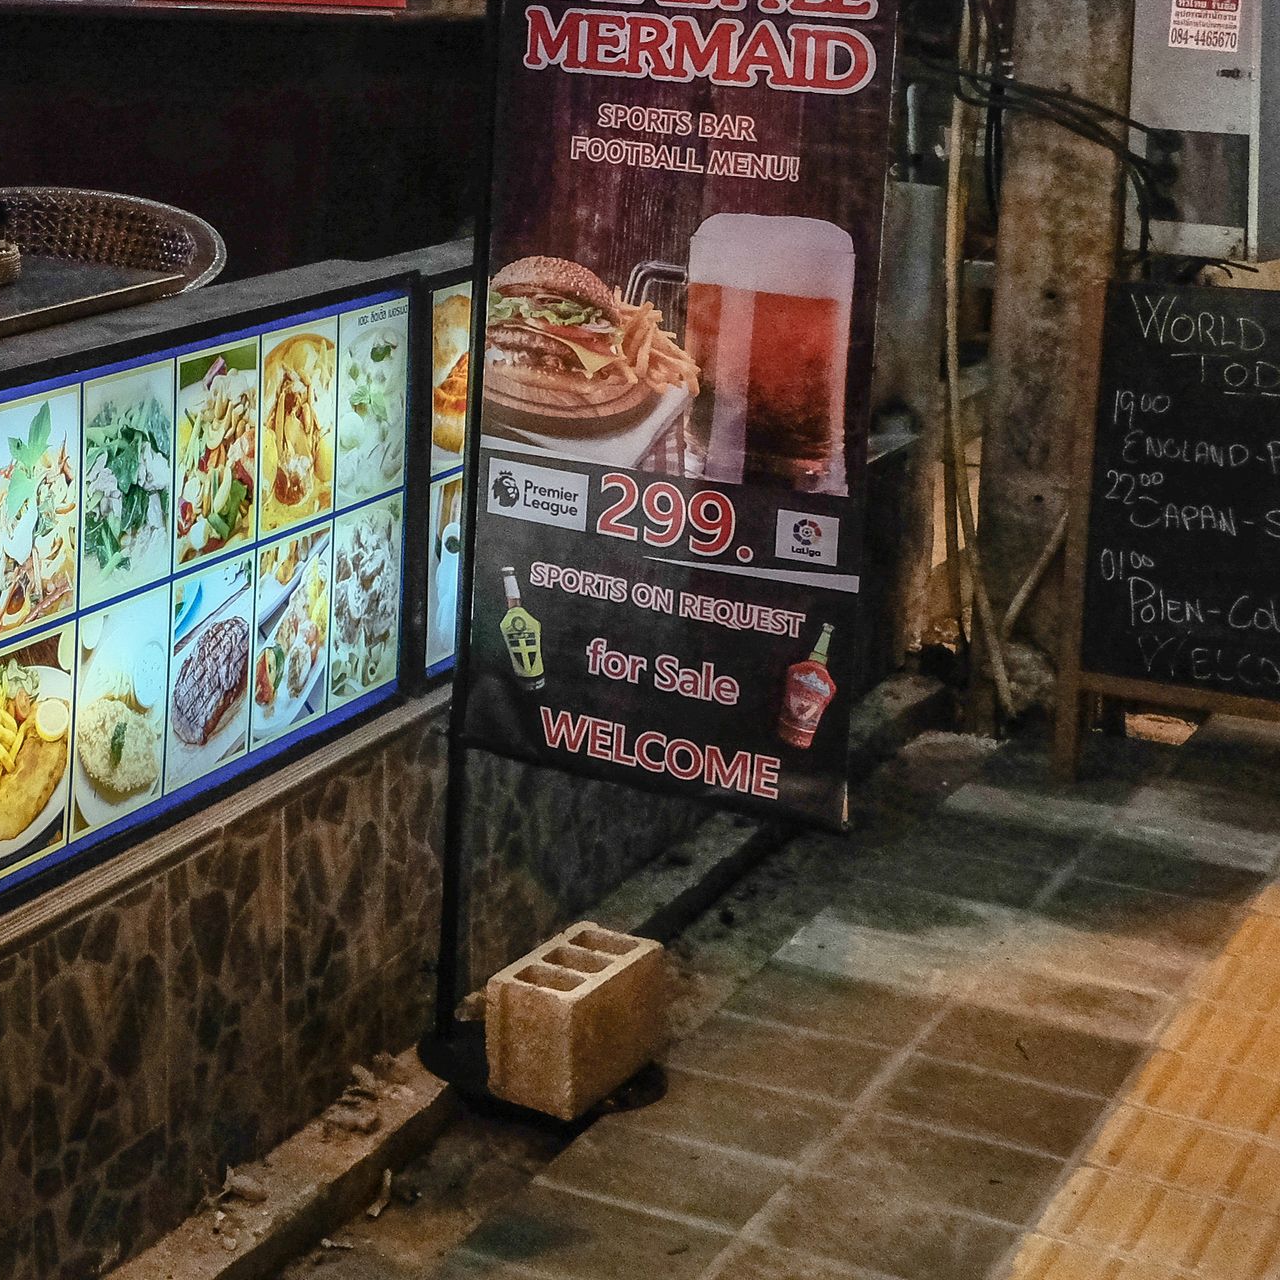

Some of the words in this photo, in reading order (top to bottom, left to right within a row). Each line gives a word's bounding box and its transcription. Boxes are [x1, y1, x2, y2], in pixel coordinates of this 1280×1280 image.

[523, 4, 877, 96] MERMAID
[1170, 27, 1237, 49] 084-4465670
[597, 103, 692, 136] SPORTS
[699, 113, 757, 143] BAR
[570, 135, 704, 174] FOOTBALL
[707, 151, 801, 183] MENU!
[1130, 293, 1266, 352] WORLD
[523, 479, 580, 505] Premier
[523, 495, 579, 518] League
[595, 471, 756, 564] 299.
[791, 545, 822, 558] LaLiga
[529, 561, 627, 603] SPORTS
[632, 582, 675, 614] ON
[679, 593, 807, 639] REQUEST
[586, 637, 647, 684] for
[652, 655, 740, 706] Sale
[539, 706, 782, 801] WELCOME
